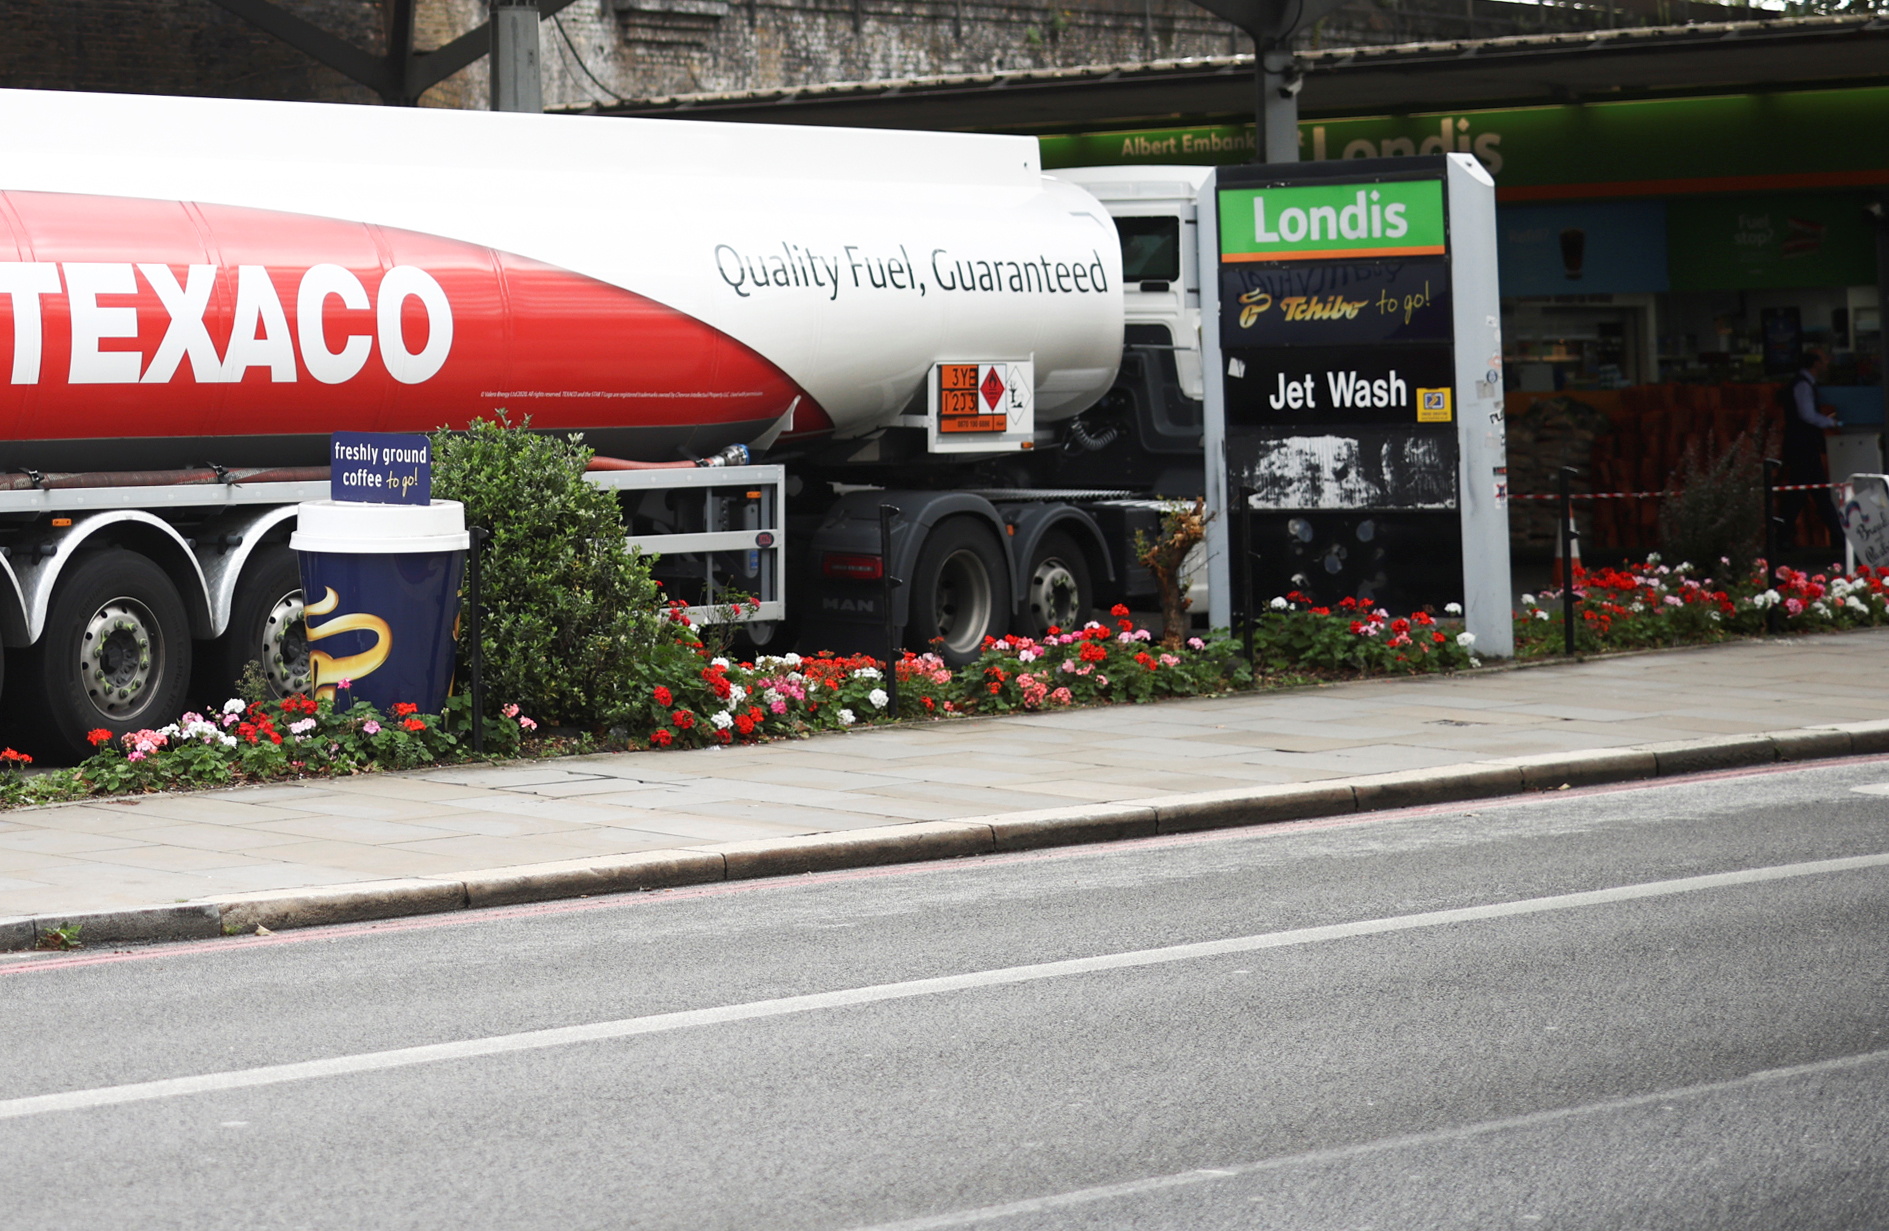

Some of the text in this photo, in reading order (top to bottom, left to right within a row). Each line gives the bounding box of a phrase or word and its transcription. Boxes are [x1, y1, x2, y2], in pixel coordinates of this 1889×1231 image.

[1121, 136, 1173, 157] Albert
[1253, 190, 1408, 243] Londis
[714, 241, 1108, 301] Quality Fuel, Guaranteed
[1280, 295, 1370, 322] Tchibo
[1375, 288, 1399, 316] to
[1402, 280, 1431, 326] go!
[952, 368, 977, 387] 3YE
[1269, 369, 1408, 410] Jet Wash
[335, 441, 427, 465] freshly ground
[343, 466, 418, 497] coffee to go!
[823, 597, 874, 612] MAN
